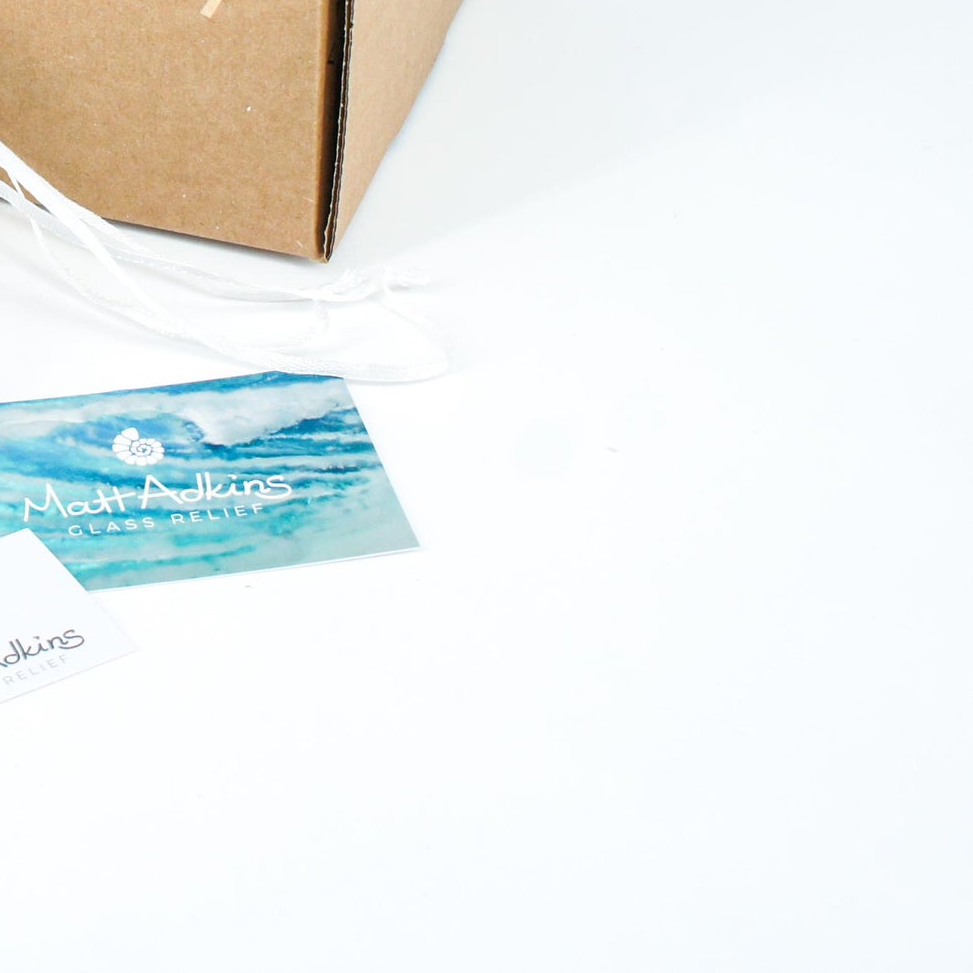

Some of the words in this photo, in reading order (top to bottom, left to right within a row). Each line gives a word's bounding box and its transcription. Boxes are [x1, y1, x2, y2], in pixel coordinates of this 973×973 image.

[23, 482, 136, 522] Matt
[137, 471, 292, 509] Adkins
[68, 516, 155, 536] GLASS
[171, 502, 265, 525] RELIEF
[2, 654, 70, 686] RELIEF
